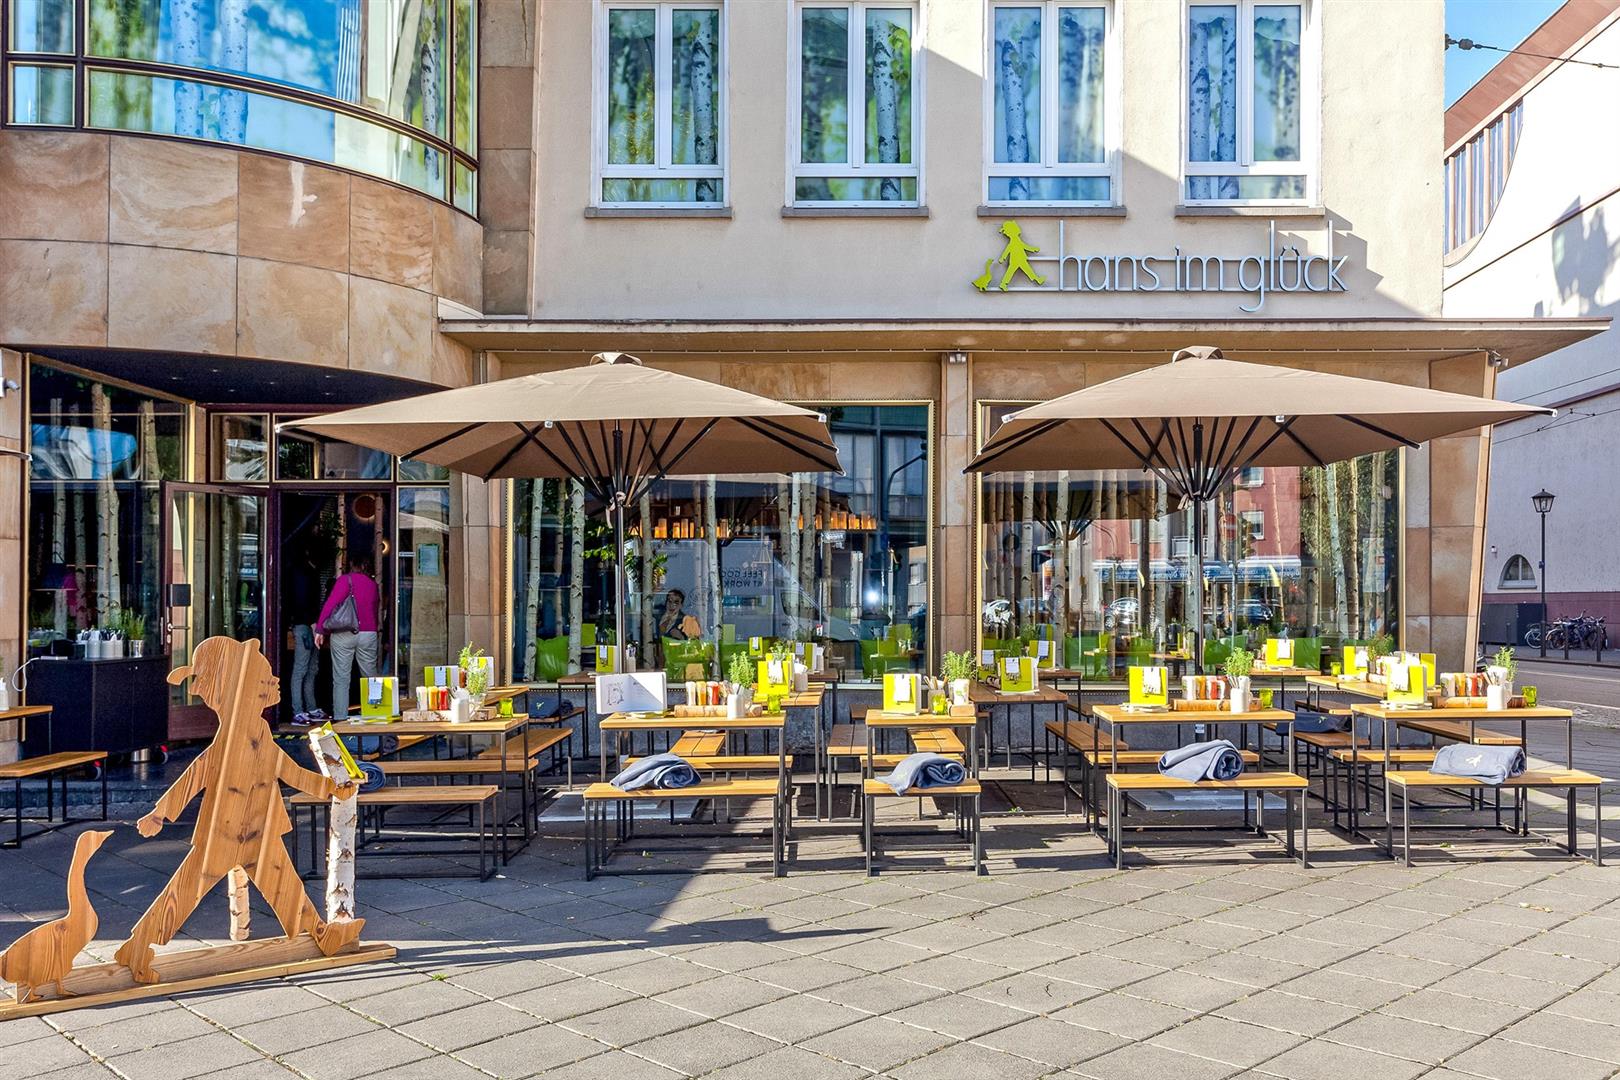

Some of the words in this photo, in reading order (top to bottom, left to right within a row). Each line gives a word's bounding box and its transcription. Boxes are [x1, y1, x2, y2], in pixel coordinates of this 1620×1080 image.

[1058, 220, 1160, 292] hans
[1174, 245, 1224, 292] im
[1237, 219, 1349, 313] glück
